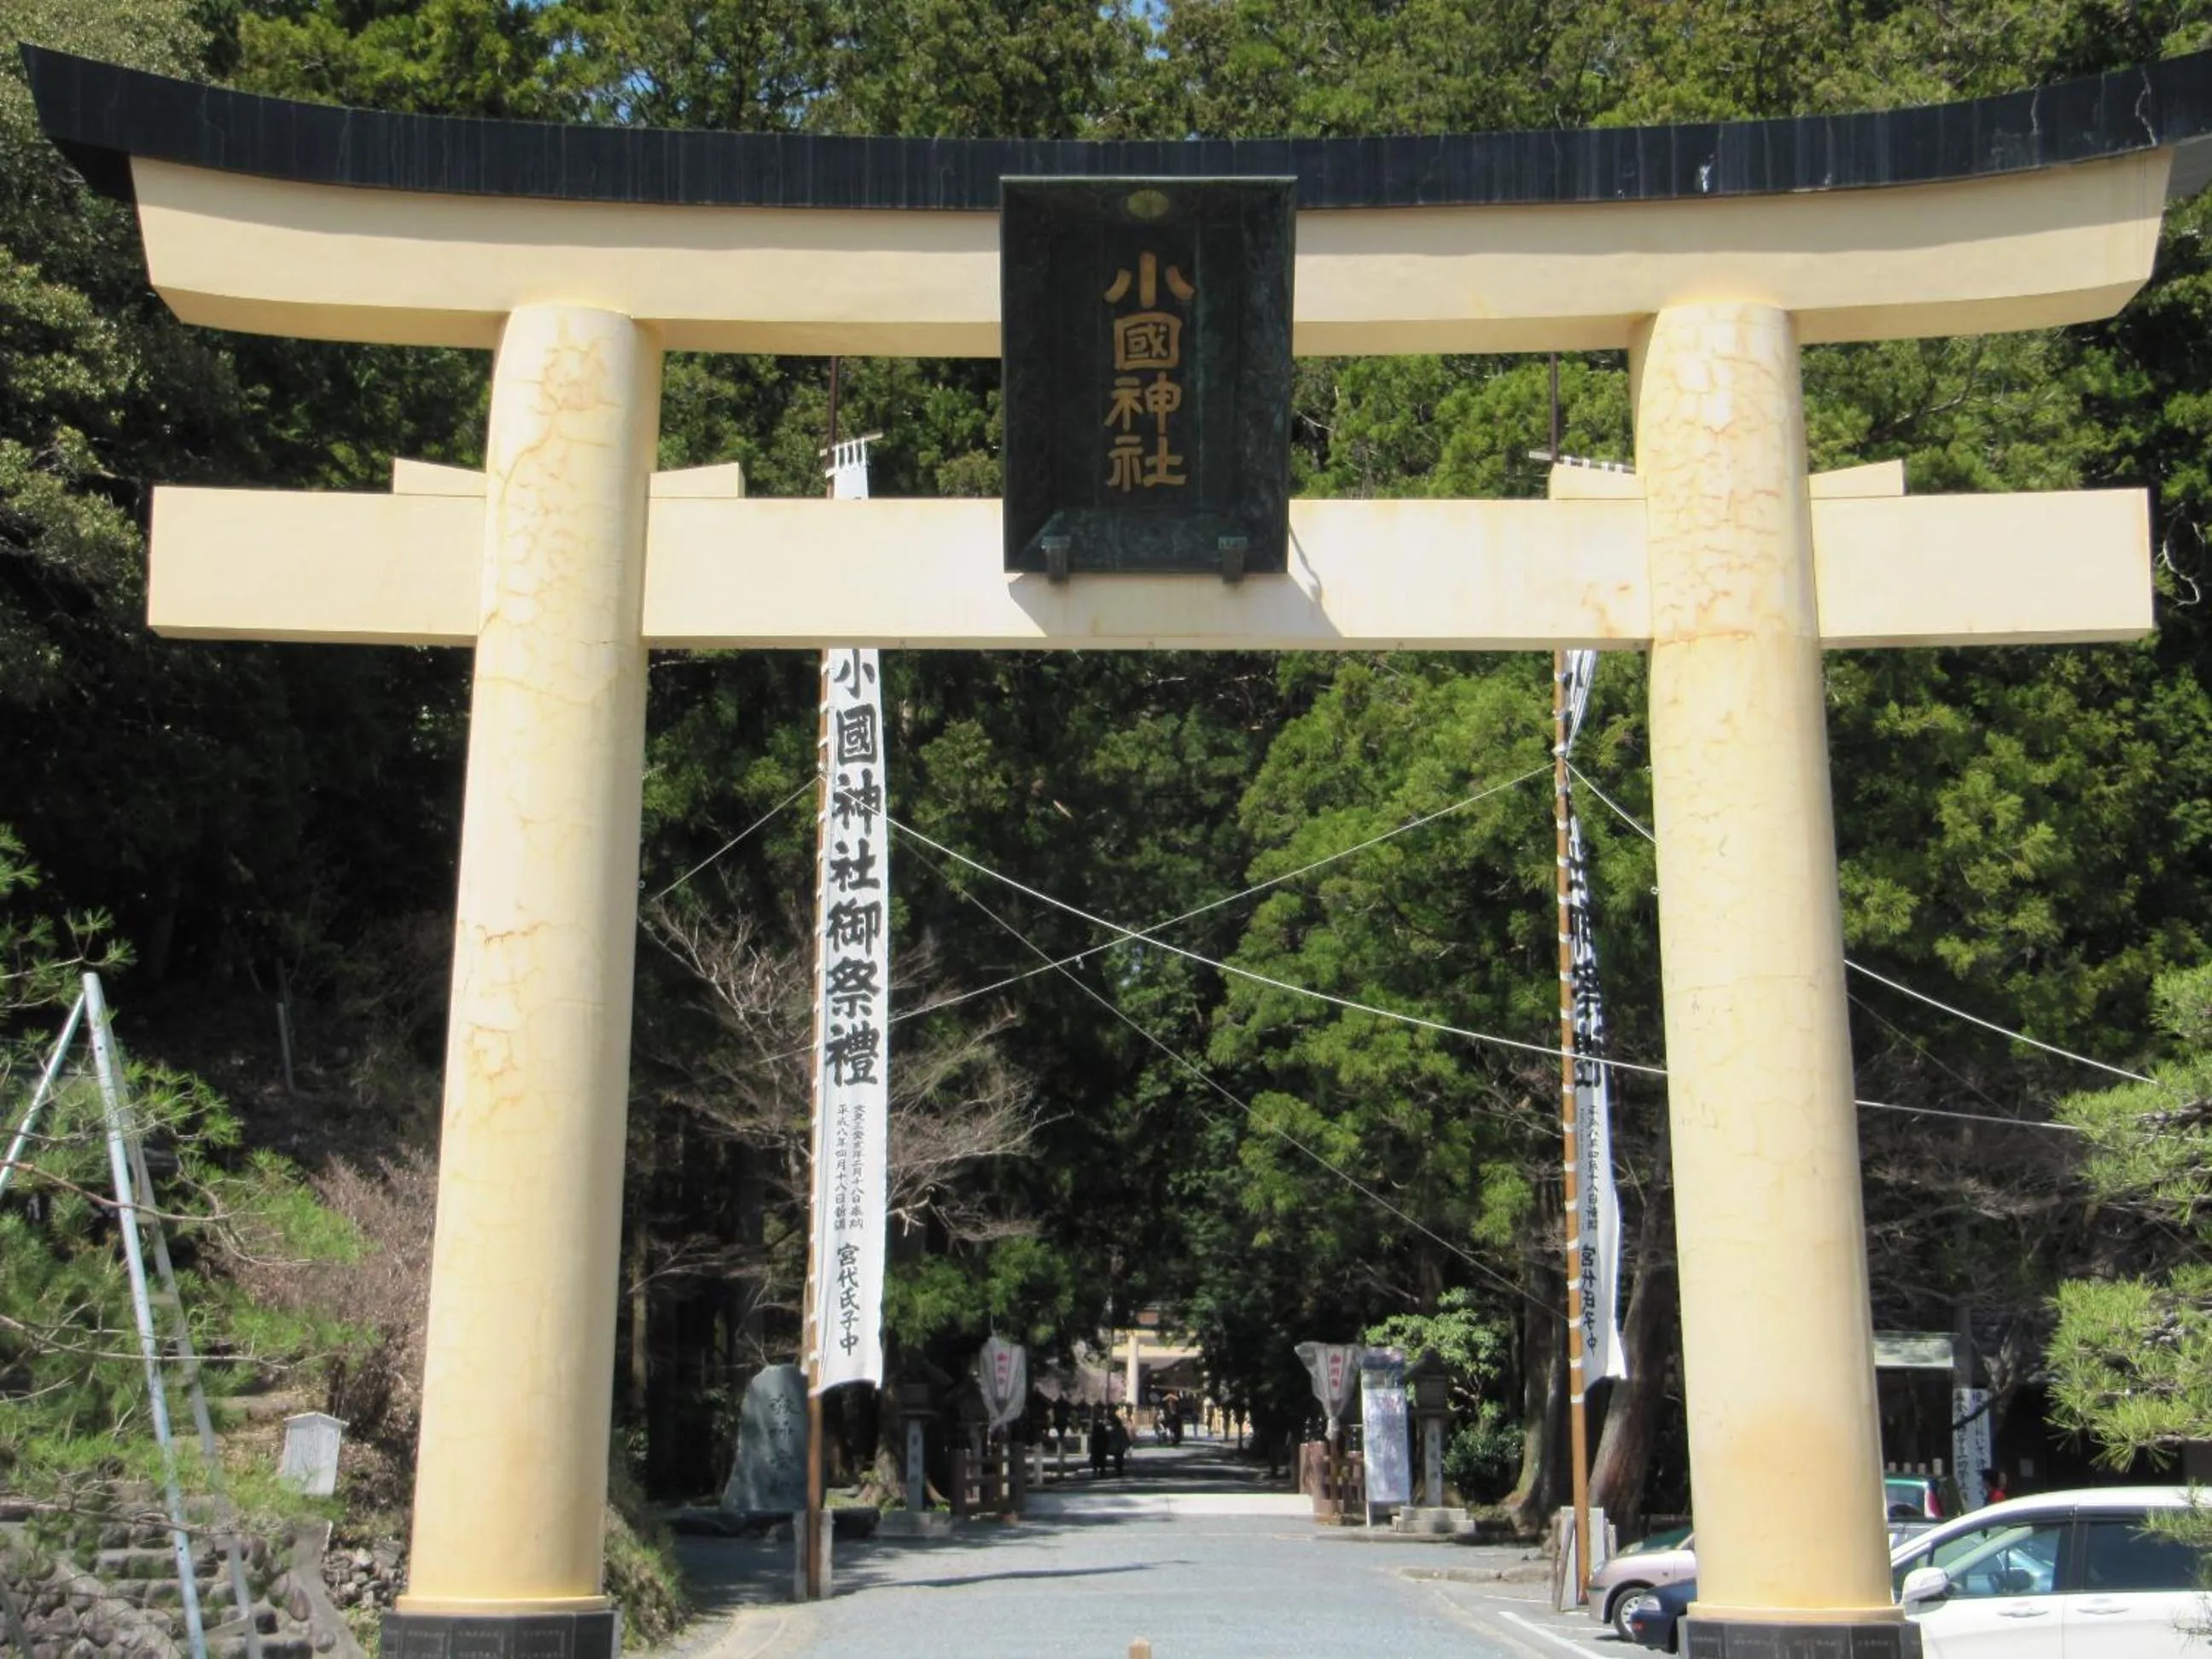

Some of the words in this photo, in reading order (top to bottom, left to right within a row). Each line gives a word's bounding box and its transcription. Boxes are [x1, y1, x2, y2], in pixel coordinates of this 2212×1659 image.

[1103, 250, 1196, 492] 小國神社
[825, 649, 882, 1086] 小國神社御祭禮
[836, 1243, 860, 1356] 宮代氏子中
